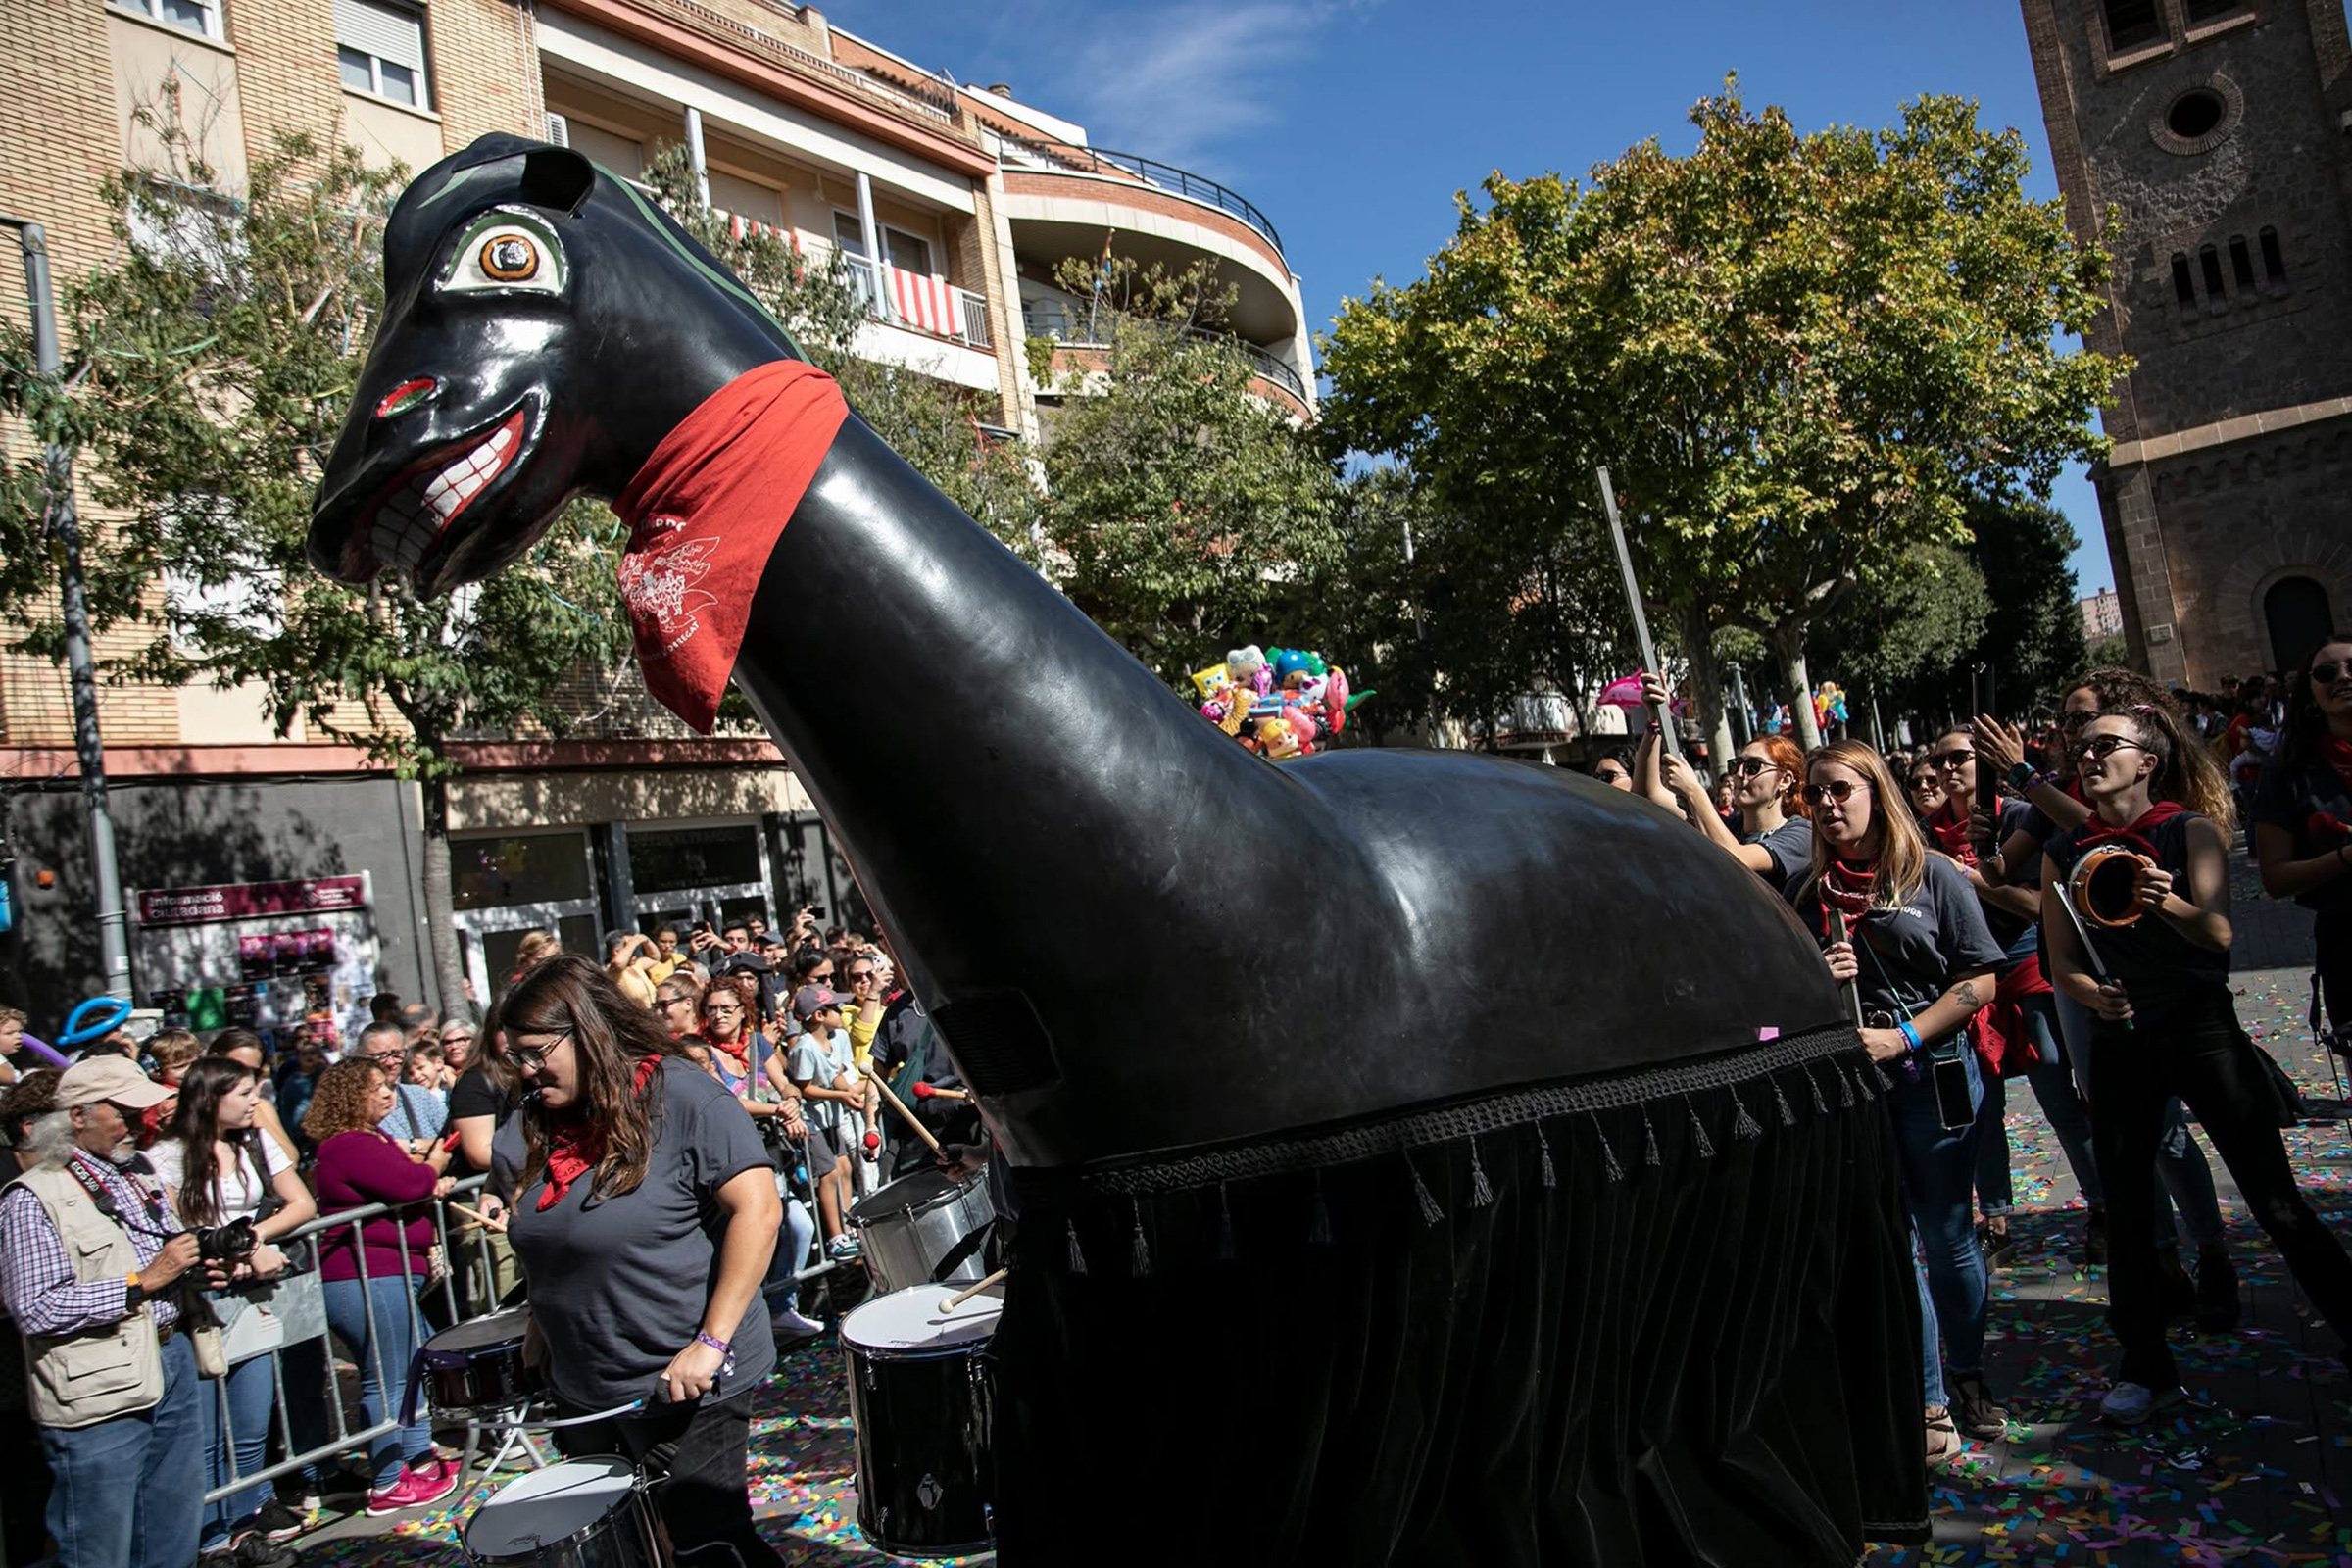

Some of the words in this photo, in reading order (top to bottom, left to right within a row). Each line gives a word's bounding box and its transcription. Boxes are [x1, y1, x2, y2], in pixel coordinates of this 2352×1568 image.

[149, 891, 224, 906] Informació
[151, 904, 225, 919] ciutadana
[71, 1160, 91, 1181] EOS
